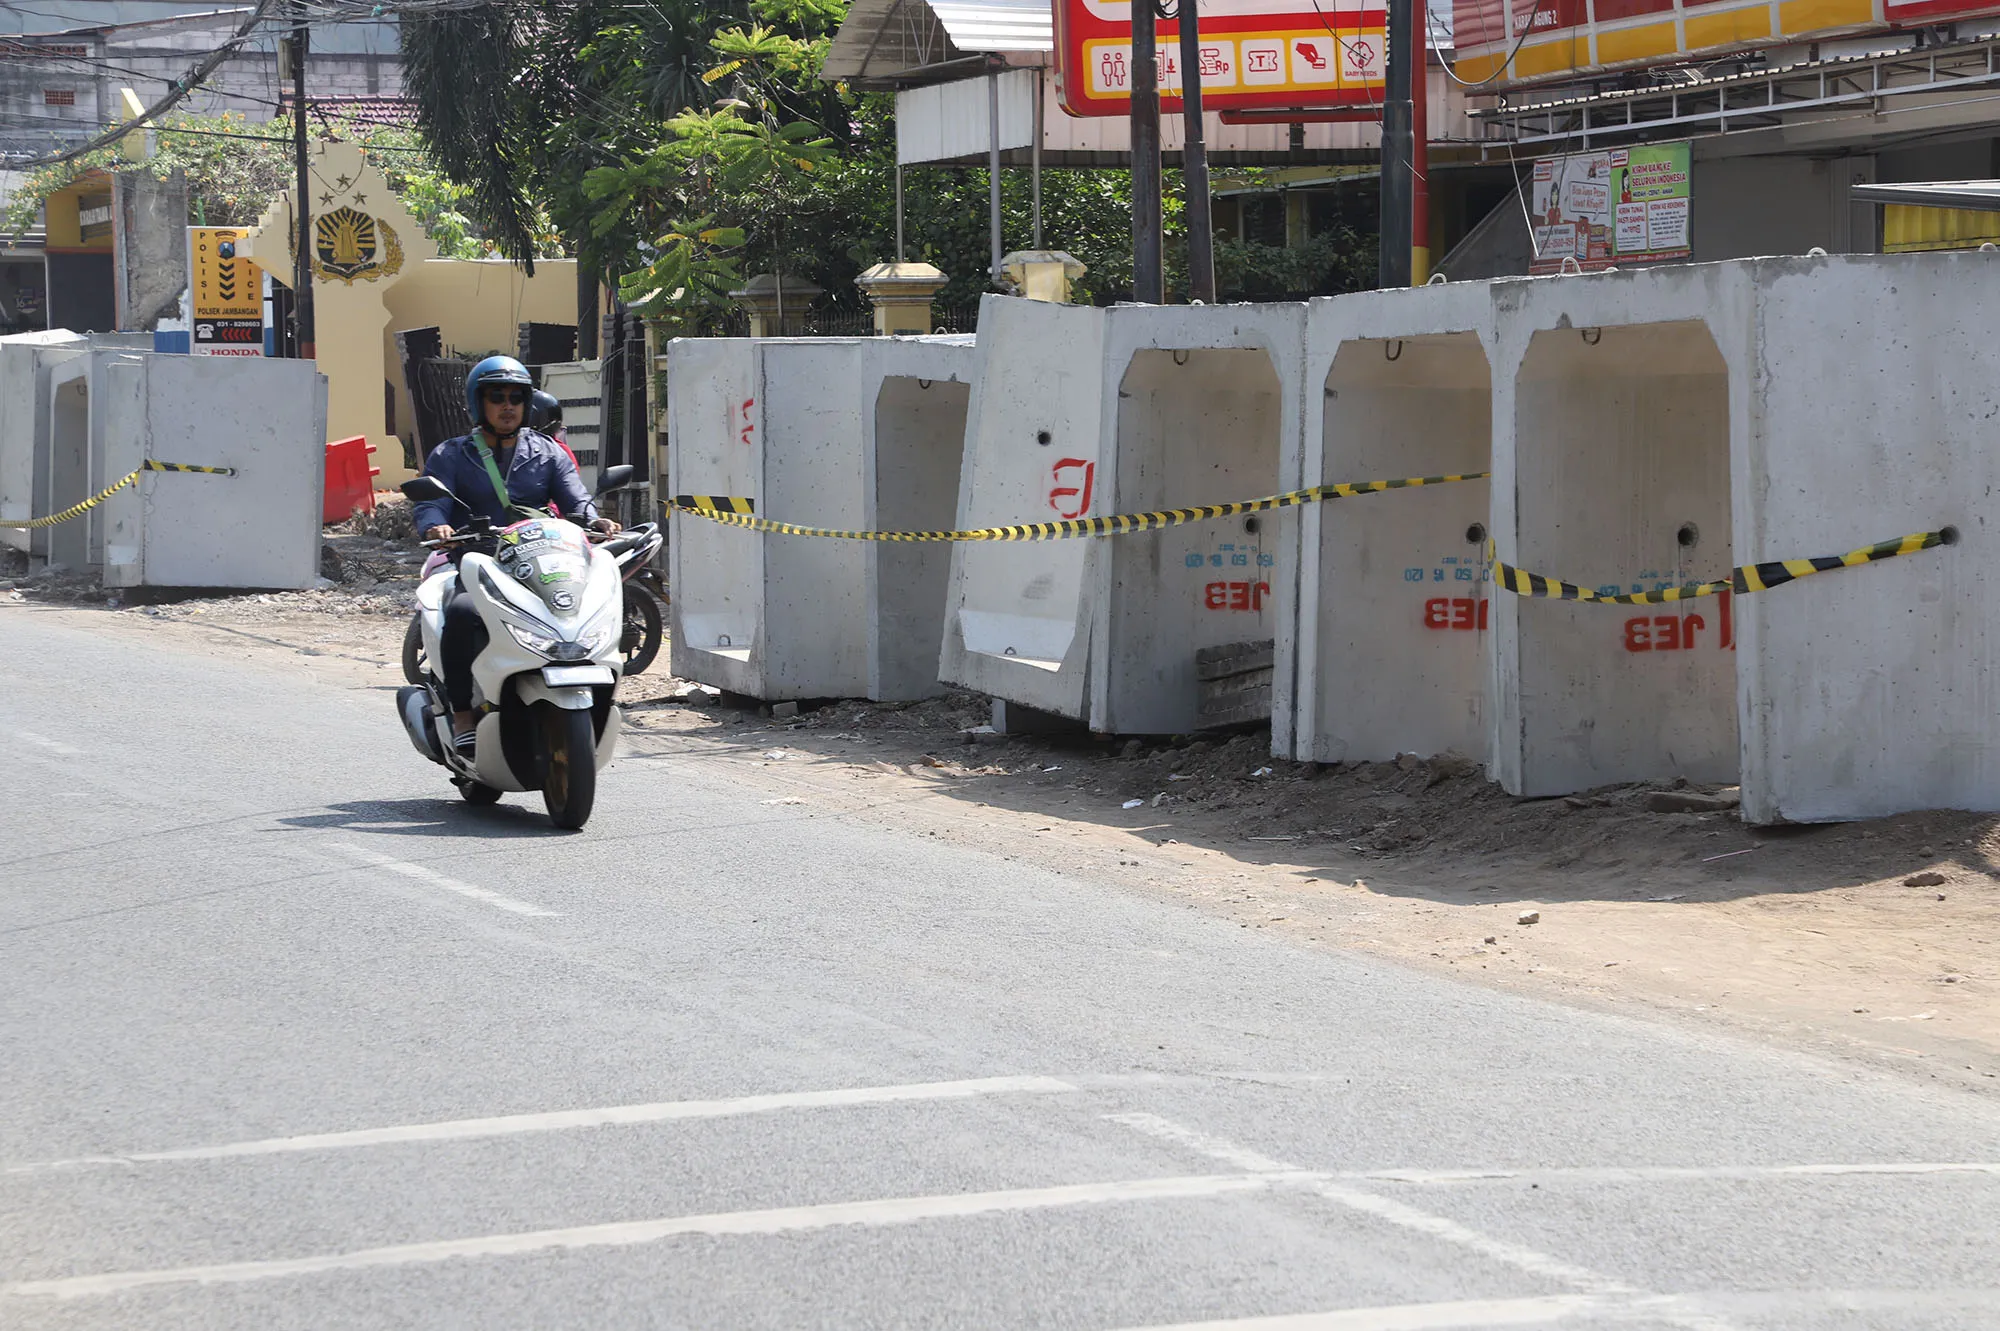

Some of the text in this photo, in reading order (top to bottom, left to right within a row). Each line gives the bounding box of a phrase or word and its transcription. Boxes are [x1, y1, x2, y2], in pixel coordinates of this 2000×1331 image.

[1552, 10, 1558, 24] 2
[200, 232, 208, 300] POLISI
[197, 307, 259, 315] POLSEK JAMBANGAN
[1204, 581, 1271, 612] JEB
[1624, 614, 1706, 653] JEB
